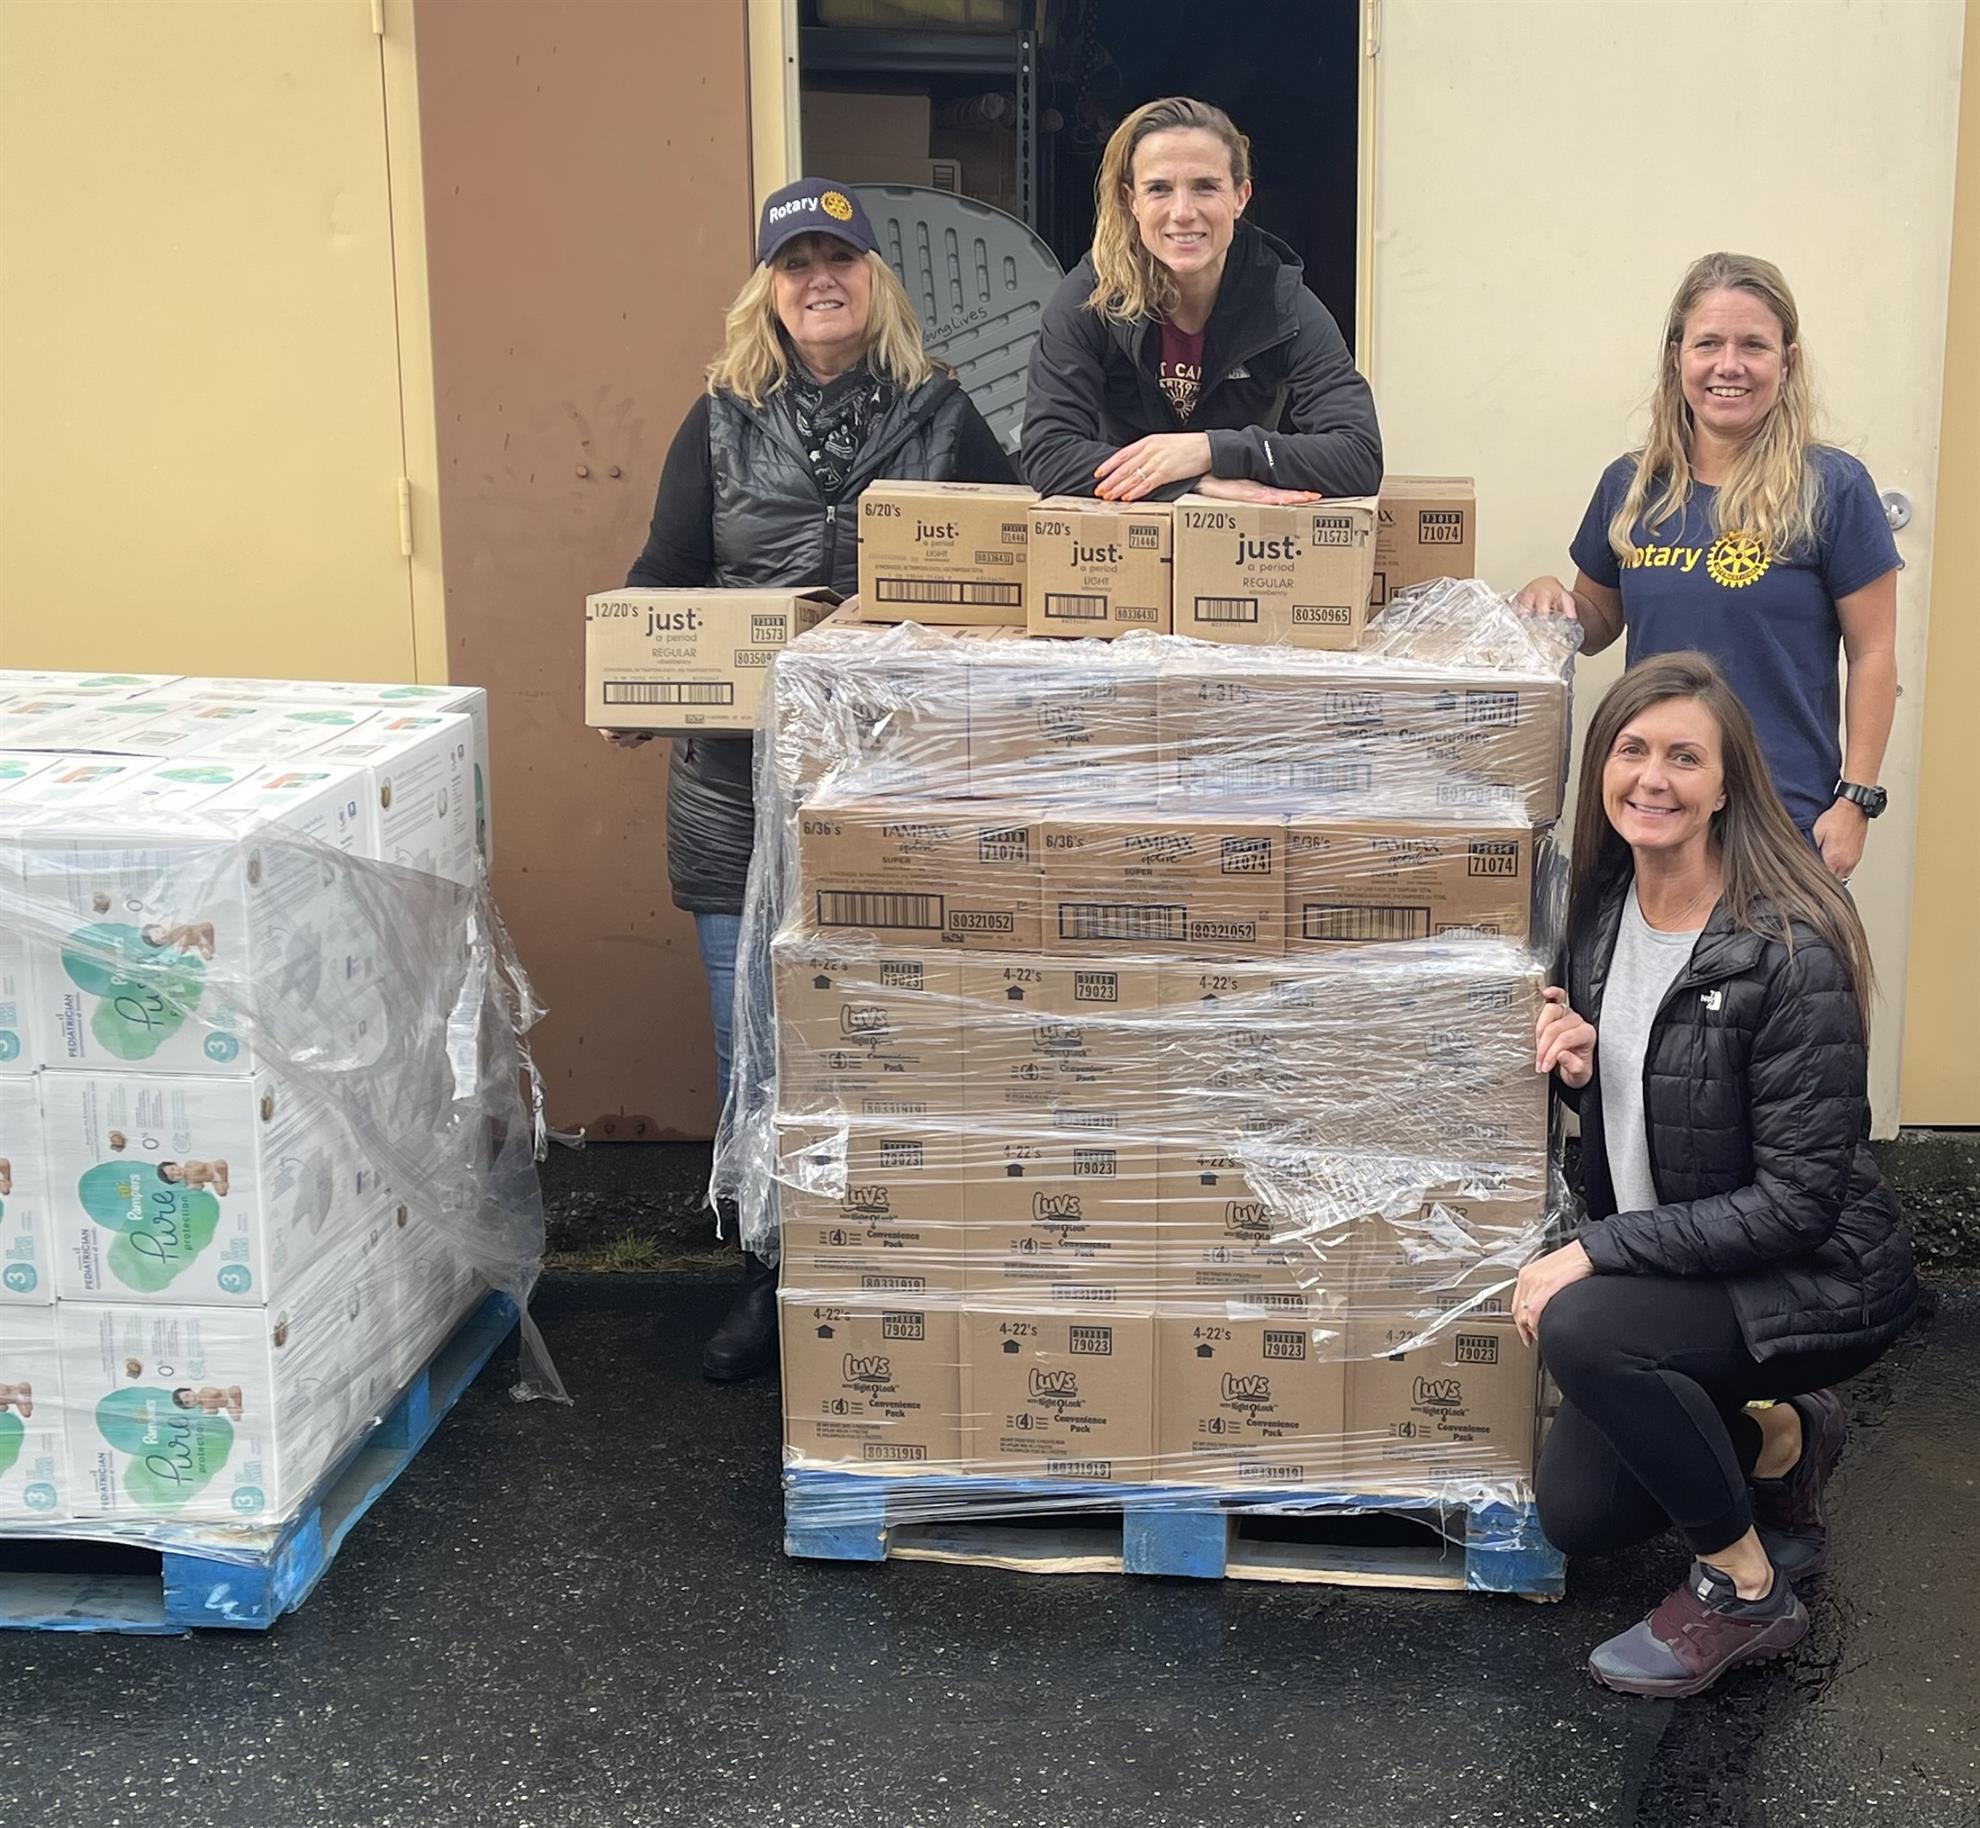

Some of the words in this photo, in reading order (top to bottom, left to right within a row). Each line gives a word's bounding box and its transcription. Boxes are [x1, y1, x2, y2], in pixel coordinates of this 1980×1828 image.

[769, 196, 818, 224] Rotary
[922, 307, 987, 343] oungLives
[865, 502, 901, 518] 6/20's
[1184, 512, 1237, 529] 12/20's
[1035, 521, 1071, 536] 6/20's
[1423, 526, 1459, 541] 71074
[1317, 531, 1350, 543] 71573
[1618, 544, 1703, 572] otary
[1092, 565, 1118, 575] period
[1248, 564, 1255, 572] a
[1260, 563, 1295, 574] period
[1083, 577, 1109, 585] LIGHT
[1243, 577, 1294, 588] REGULAR
[594, 603, 639, 618] 12/20's
[1295, 609, 1349, 622] 80350965
[655, 634, 662, 642] a
[666, 633, 698, 644] period
[755, 628, 784, 640] 71573
[652, 648, 697, 658] REGULAR
[737, 652, 777, 664] 803509
[803, 822, 841, 836] 6/36's
[1046, 835, 1084, 848] 6/36's
[1473, 857, 1513, 873] 71074
[952, 914, 1011, 929] 80321052
[1194, 924, 1252, 939] 80321052
[1003, 967, 1042, 982] 4-22's
[1199, 976, 1238, 990] 4-22's
[1078, 985, 1115, 999] 79023
[68, 993, 77, 1057] PEDIATRICIAN
[207, 1041, 228, 1053] 3
[1077, 1162, 1113, 1175] 79023
[127, 1174, 144, 1221] Pampers
[1032, 1191, 1081, 1221] Luvs
[130, 1190, 180, 1264] Pure
[183, 1196, 193, 1251] protection
[833, 1229, 842, 1245] 4
[867, 1230, 920, 1240] Convenience
[883, 1240, 904, 1248] Pack
[81, 1228, 93, 1290] PEDIATRICIAN
[7, 1271, 27, 1284] 3
[221, 1272, 240, 1285] 3
[885, 1324, 921, 1337] 79023
[999, 1322, 1038, 1337] 4-22's
[1192, 1326, 1231, 1341] 4-22's
[1385, 1329, 1417, 1342] 4-22'
[1072, 1338, 1109, 1352] 79023
[1266, 1343, 1302, 1357] 79023
[1459, 1347, 1494, 1360] 79023
[842, 1352, 890, 1382] Luvs
[1028, 1367, 1077, 1398] Luvs
[1221, 1372, 1270, 1401] Luvs
[1412, 1376, 1461, 1406] Luvs
[835, 1398, 845, 1414] 4
[868, 1399, 921, 1409] Convenience
[885, 1409, 905, 1418] Pack
[1054, 1414, 1107, 1424] Convenience
[1019, 1413, 1029, 1429] 4
[1211, 1417, 1221, 1433] 4
[1246, 1418, 1299, 1429] Convenience
[1437, 1423, 1490, 1433] Convenience
[1070, 1425, 1091, 1433] Pack
[1262, 1429, 1283, 1437] Pack
[1402, 1421, 1412, 1438] 4
[1453, 1433, 1474, 1441] Pack
[867, 1446, 922, 1460] 80331919
[1052, 1462, 1106, 1476] 80331919
